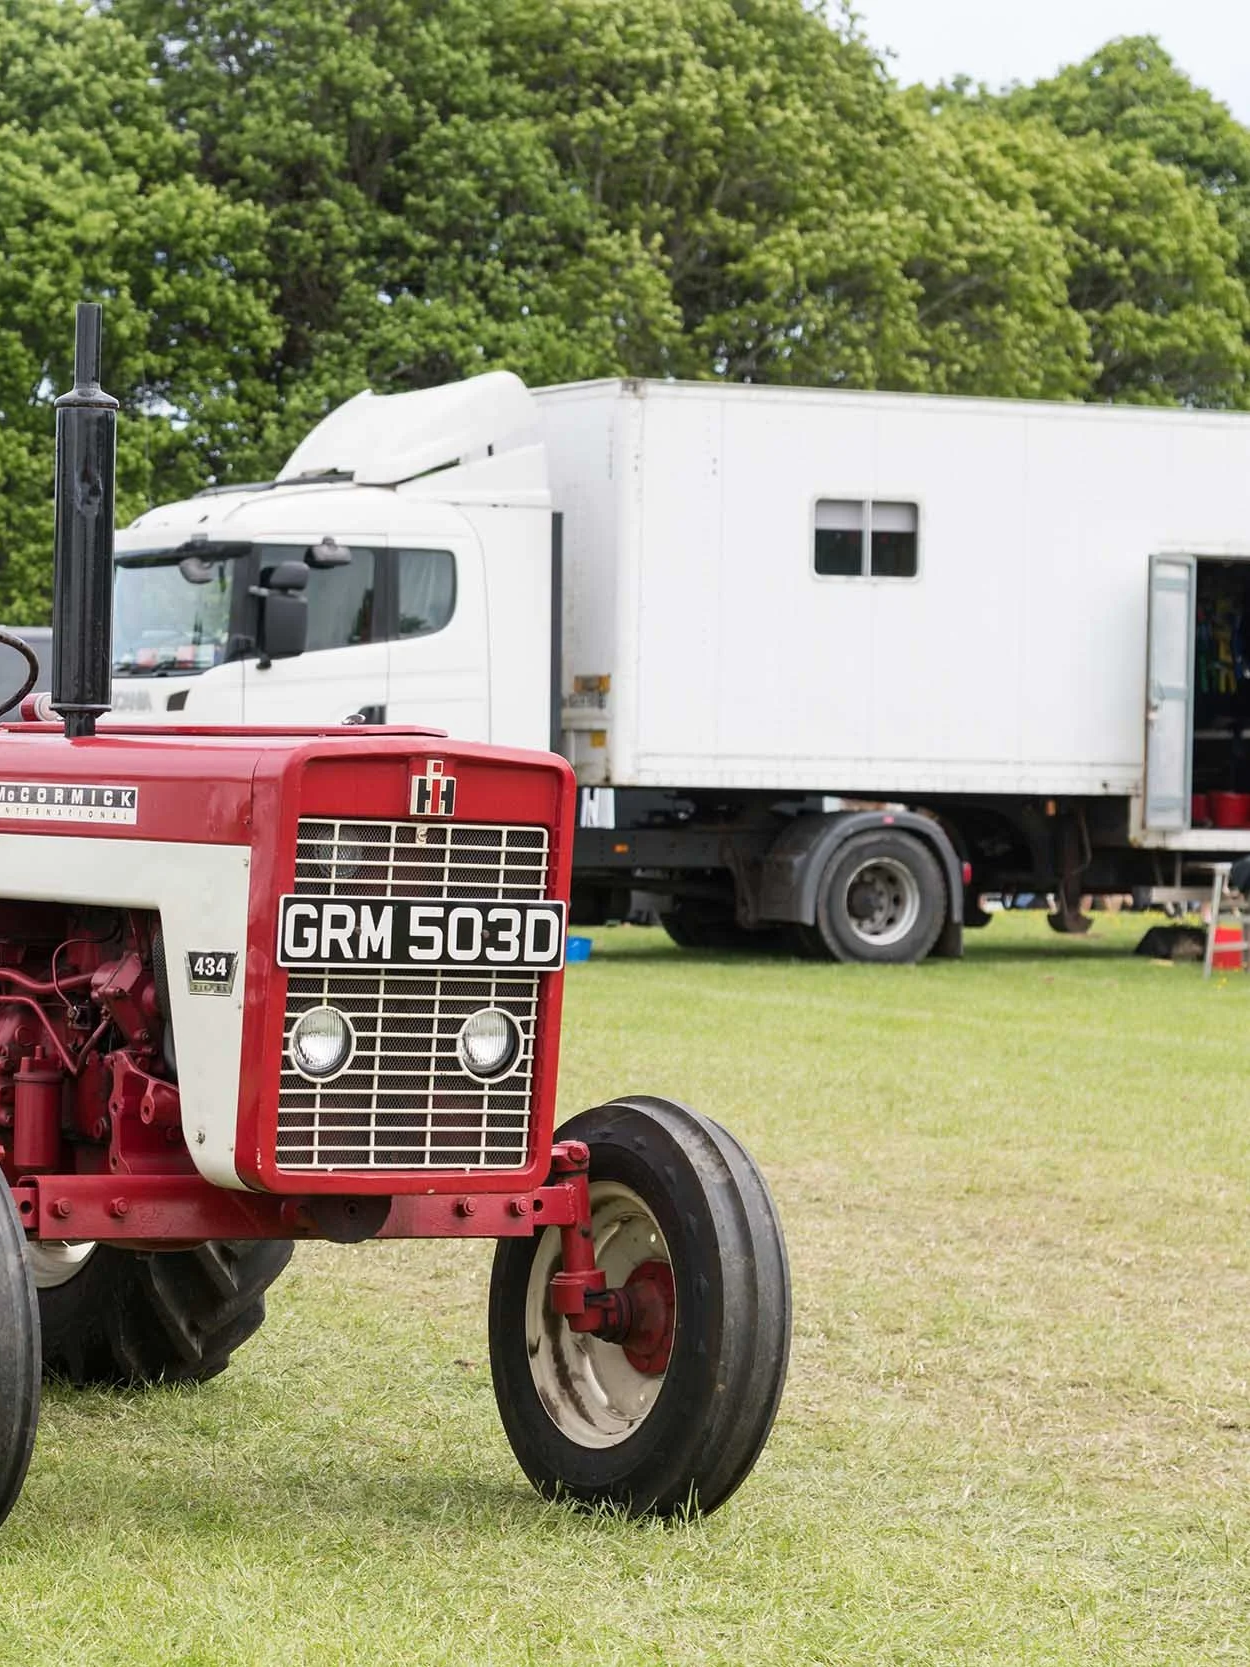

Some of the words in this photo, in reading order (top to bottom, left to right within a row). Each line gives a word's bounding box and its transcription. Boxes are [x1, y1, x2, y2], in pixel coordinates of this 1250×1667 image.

[285, 903, 393, 959] GRM
[408, 905, 560, 962] 503D
[194, 957, 227, 976] 434
